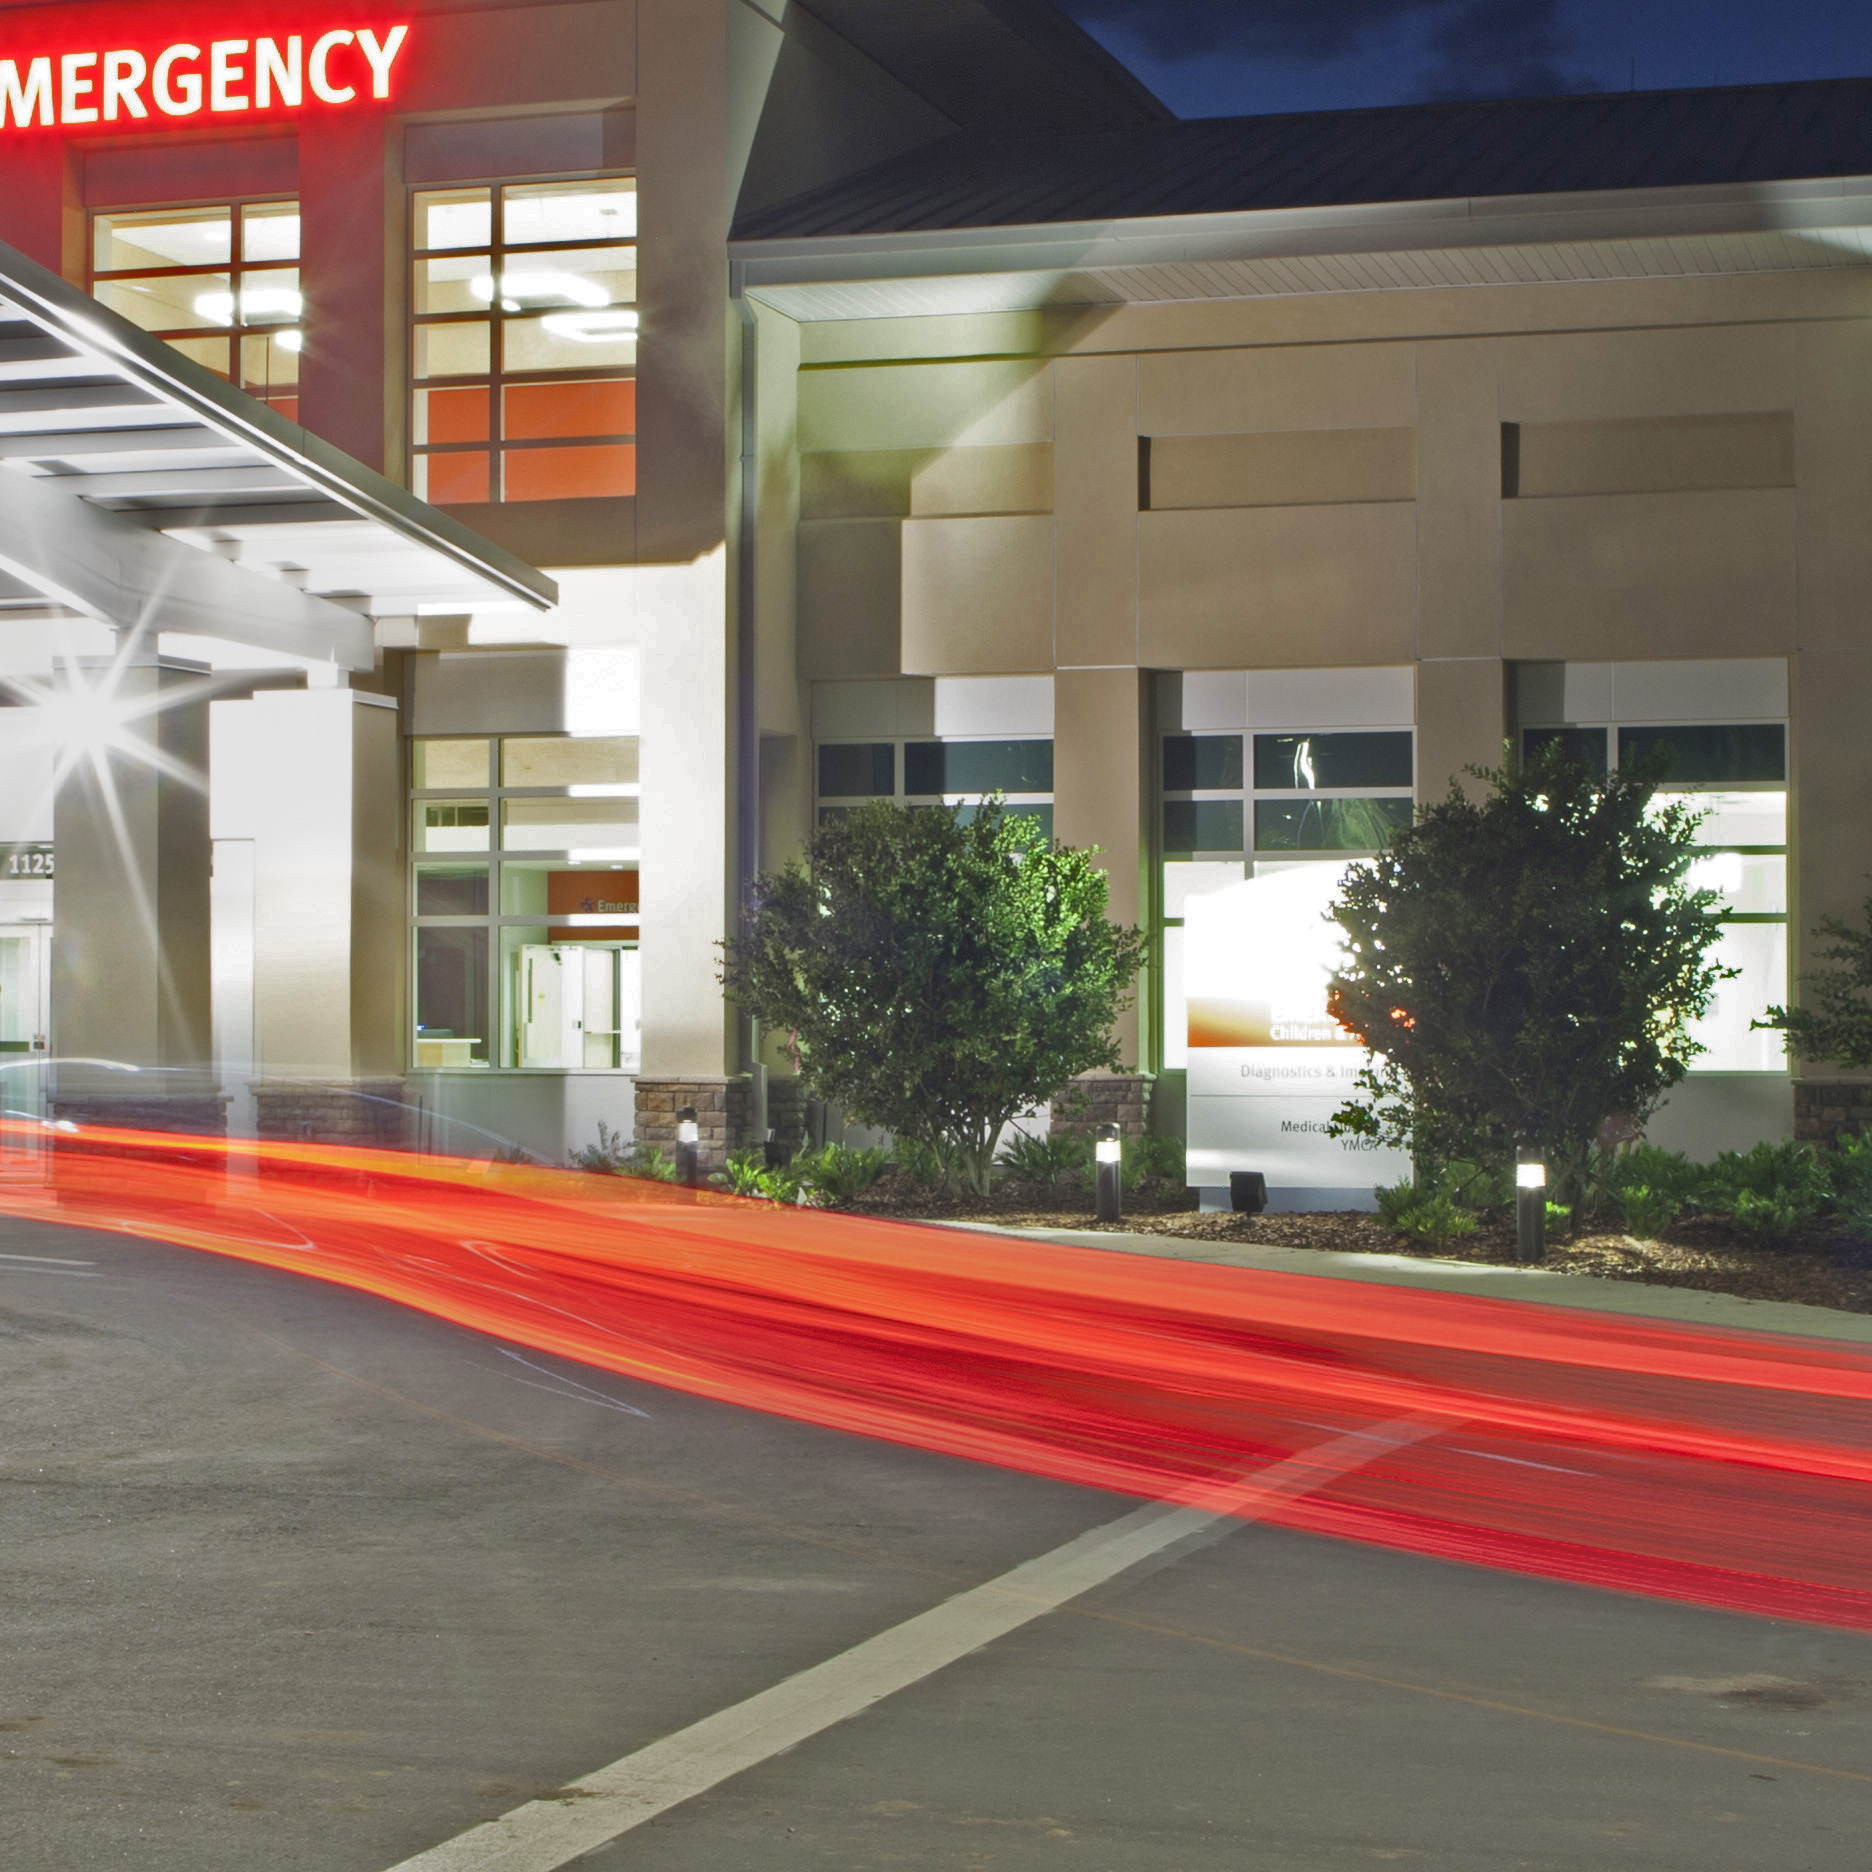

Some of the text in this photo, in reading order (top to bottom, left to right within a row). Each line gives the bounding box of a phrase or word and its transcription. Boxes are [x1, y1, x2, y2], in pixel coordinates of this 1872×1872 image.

[597, 899, 639, 914] Emerg
[1240, 1064, 1321, 1080] Diagnostics
[1326, 1064, 1336, 1078] &
[1280, 1120, 1330, 1133] Medical
[1341, 1139, 1378, 1152] YMCA
